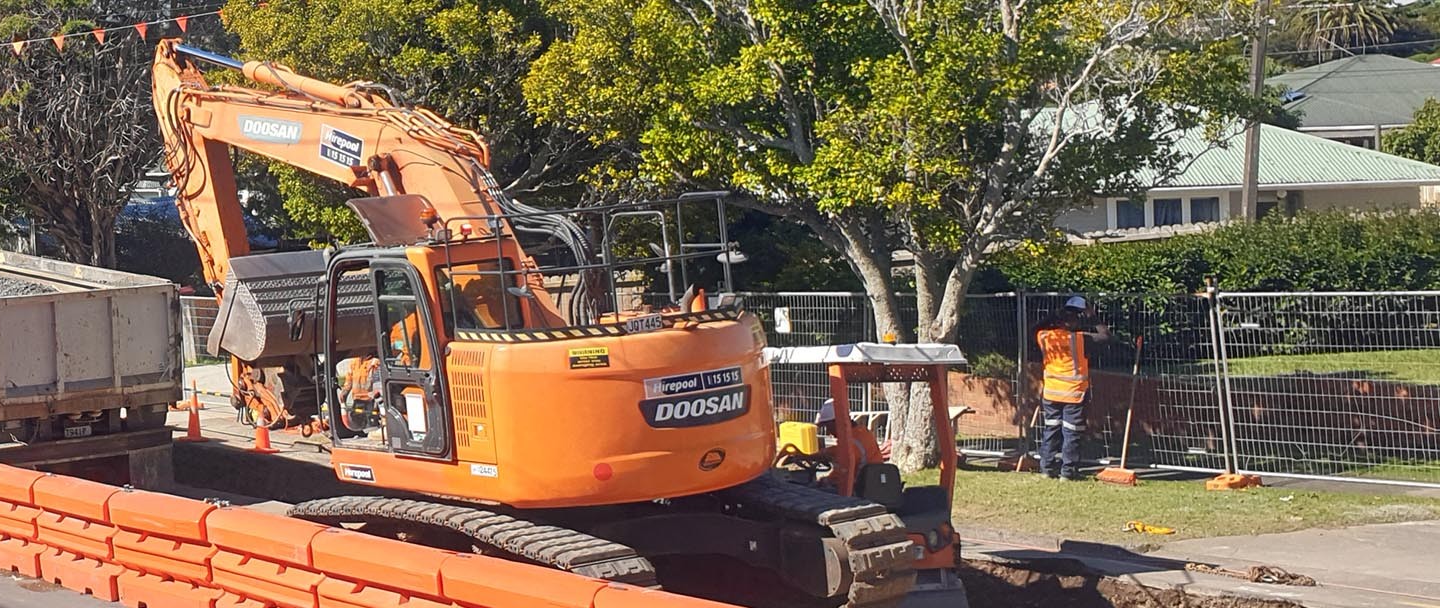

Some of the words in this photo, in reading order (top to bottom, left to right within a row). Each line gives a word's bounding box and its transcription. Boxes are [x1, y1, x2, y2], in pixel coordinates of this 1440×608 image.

[243, 119, 298, 140] DOOSAN
[324, 130, 360, 153] Hirepool
[653, 378, 697, 394] Hirepool
[654, 391, 744, 422] DOOSAN
